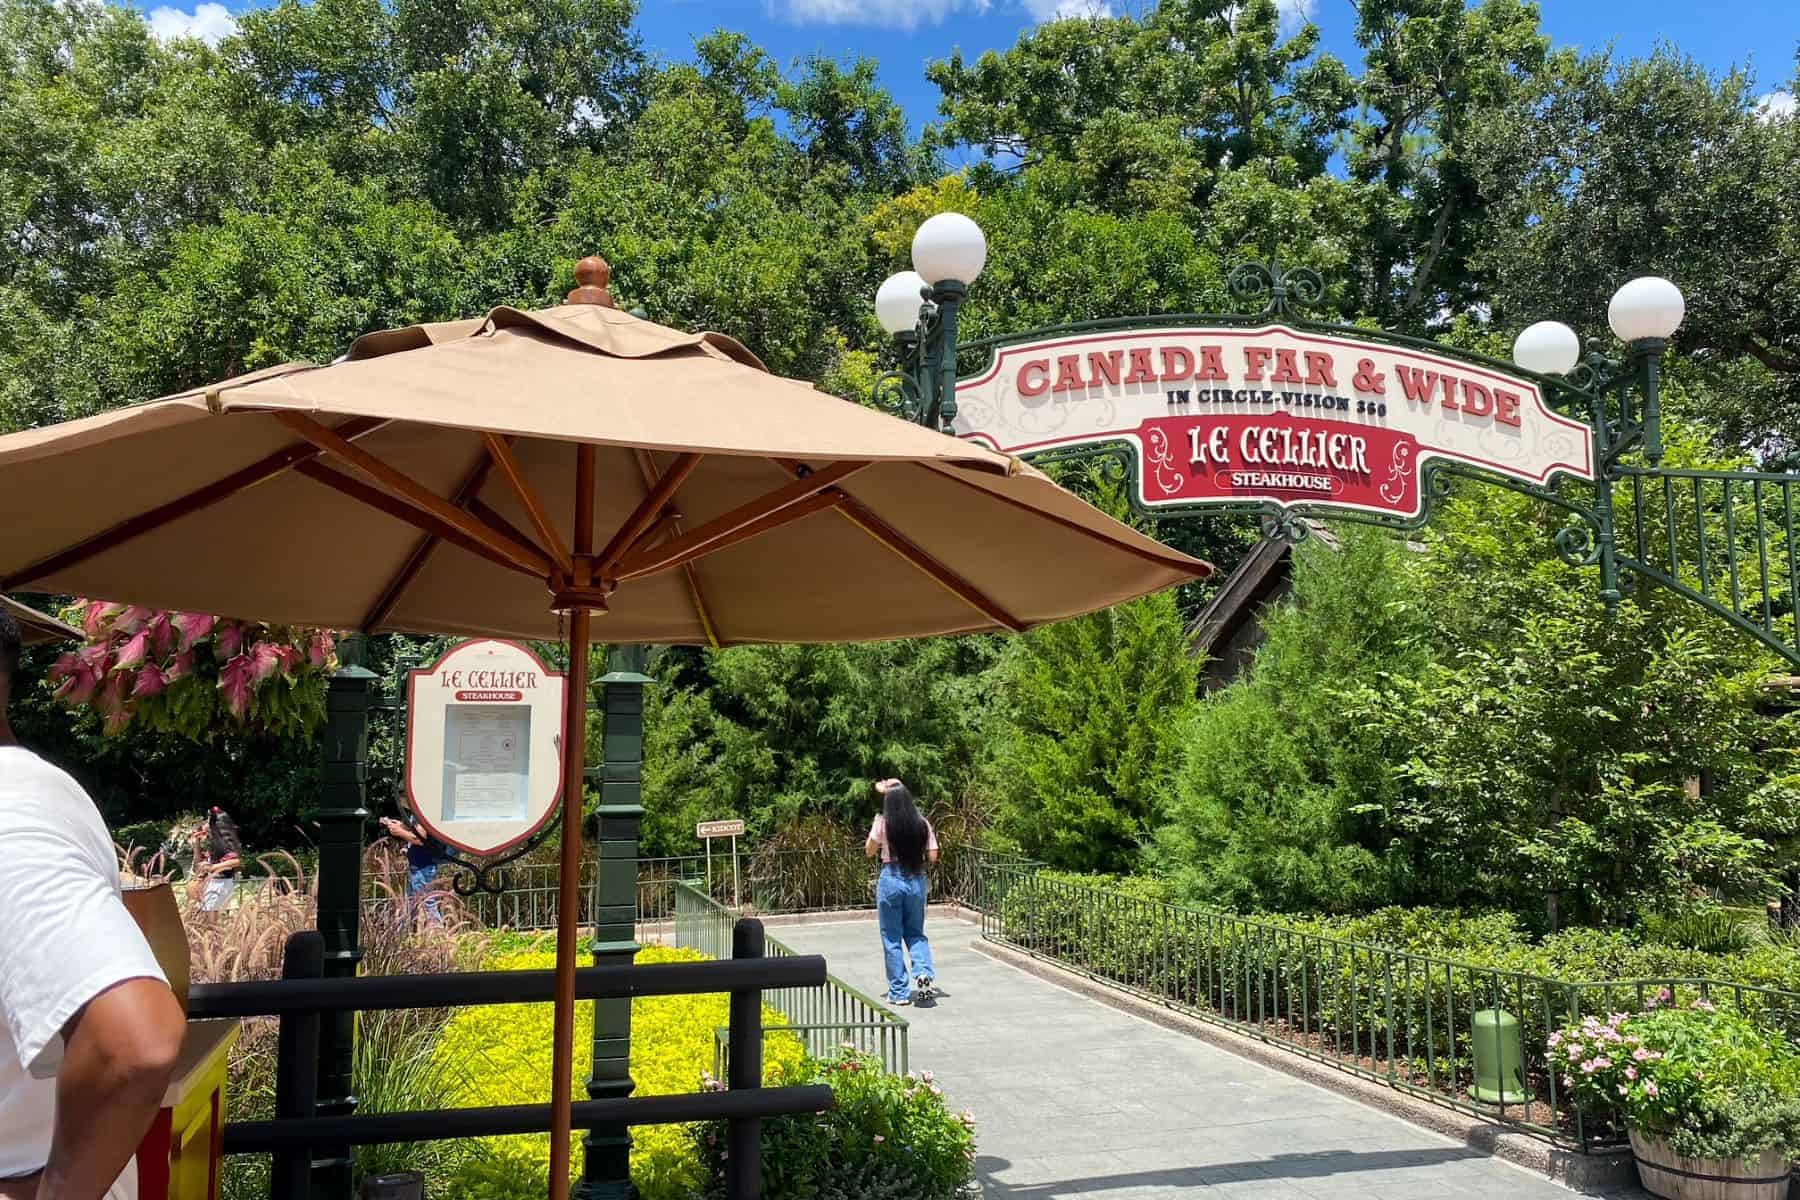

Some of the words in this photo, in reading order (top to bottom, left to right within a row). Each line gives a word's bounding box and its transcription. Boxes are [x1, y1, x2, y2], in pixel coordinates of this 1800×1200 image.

[1017, 345, 1229, 397] CANADA
[1243, 347, 1338, 388] FAR
[1352, 358, 1386, 395] &
[1395, 364, 1522, 428] WIDE
[1167, 390, 1191, 404] IN
[1198, 389, 1350, 411] CIRCLE-VISION
[1356, 400, 1386, 417] 360
[1187, 425, 1231, 465] LE
[1239, 426, 1371, 474] CELLIER
[1231, 472, 1333, 491] STEAKHOUSE
[441, 670, 462, 688] LE
[468, 670, 537, 689] CELLIER
[463, 692, 516, 700] STEAKHOUSE
